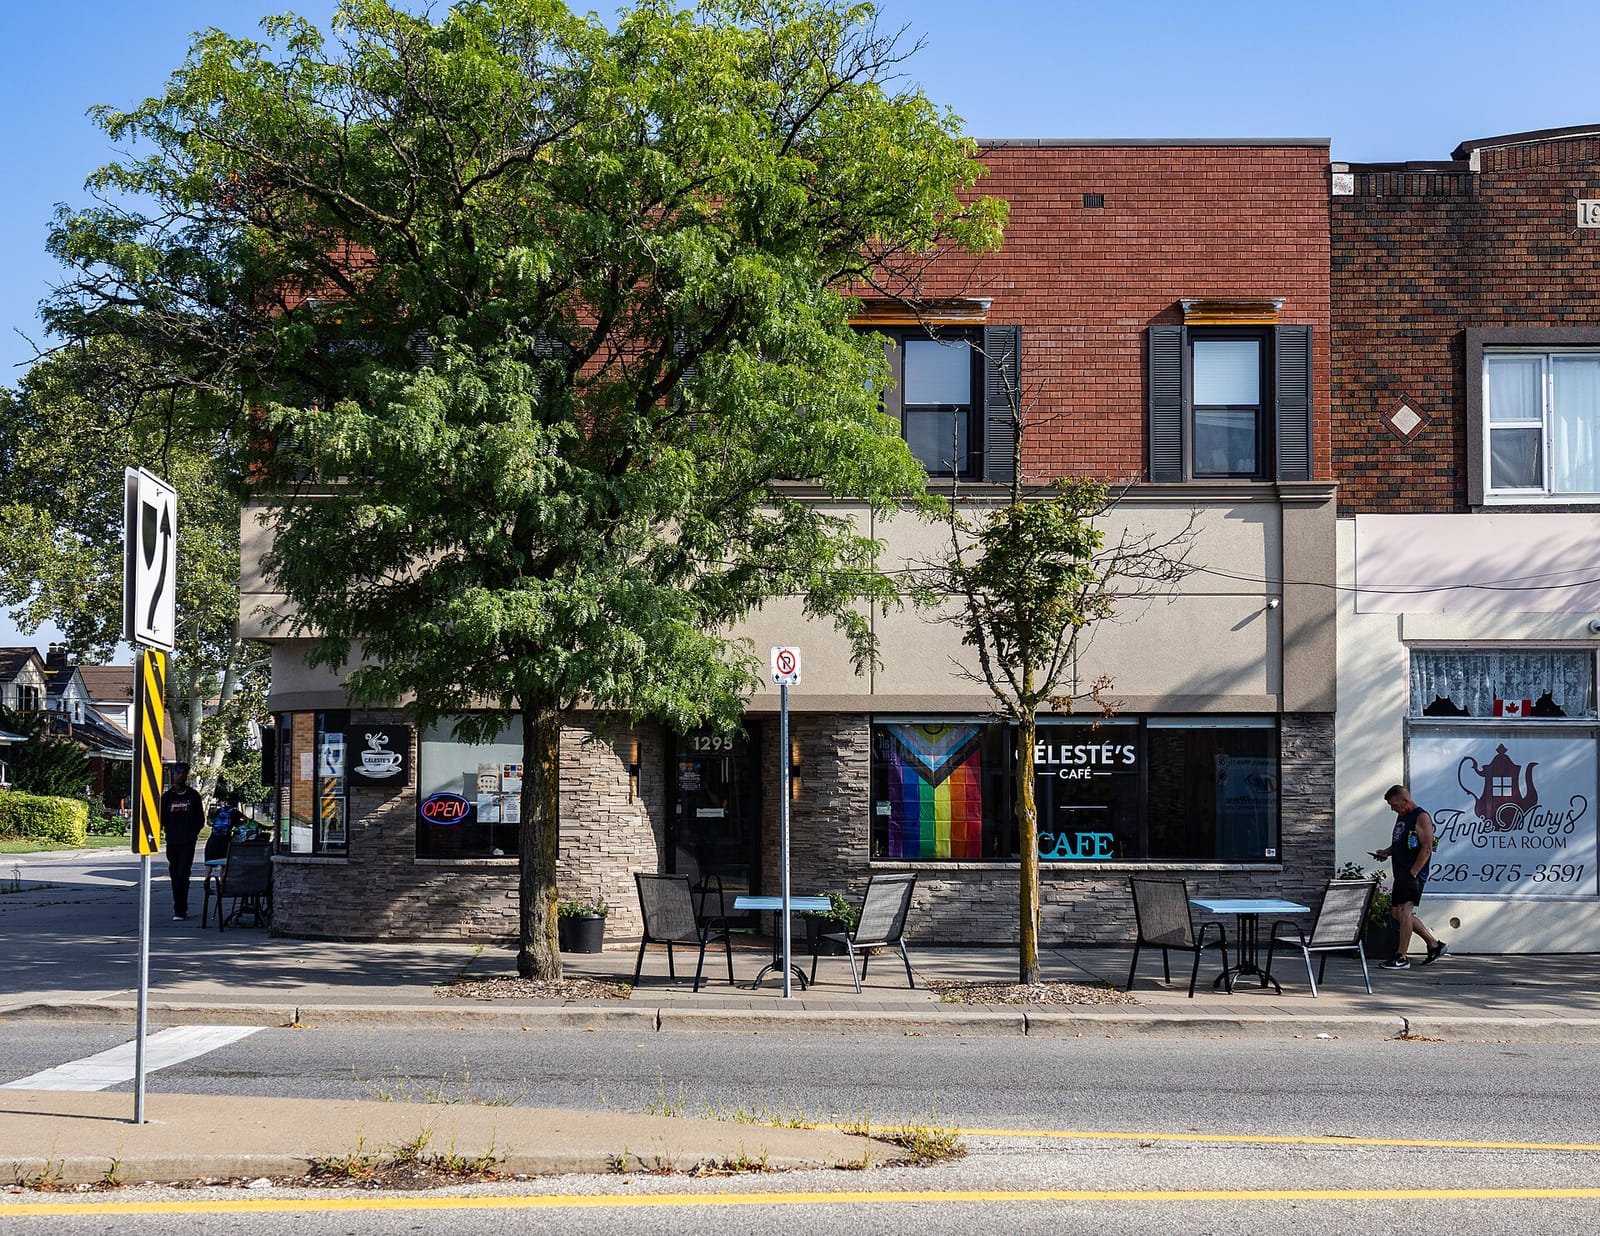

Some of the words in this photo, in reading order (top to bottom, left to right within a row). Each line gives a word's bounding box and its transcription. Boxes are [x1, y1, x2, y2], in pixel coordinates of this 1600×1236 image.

[694, 736, 733, 750] 1295
[1059, 766, 1092, 779] CAFÉ
[423, 801, 466, 817] OPEN
[1432, 808, 1494, 848] Annie
[1037, 831, 1115, 860] CAFE
[1489, 836, 1517, 849] TEA
[1521, 836, 1567, 849] ROOM
[1428, 863, 1585, 883] 226-975-3591
